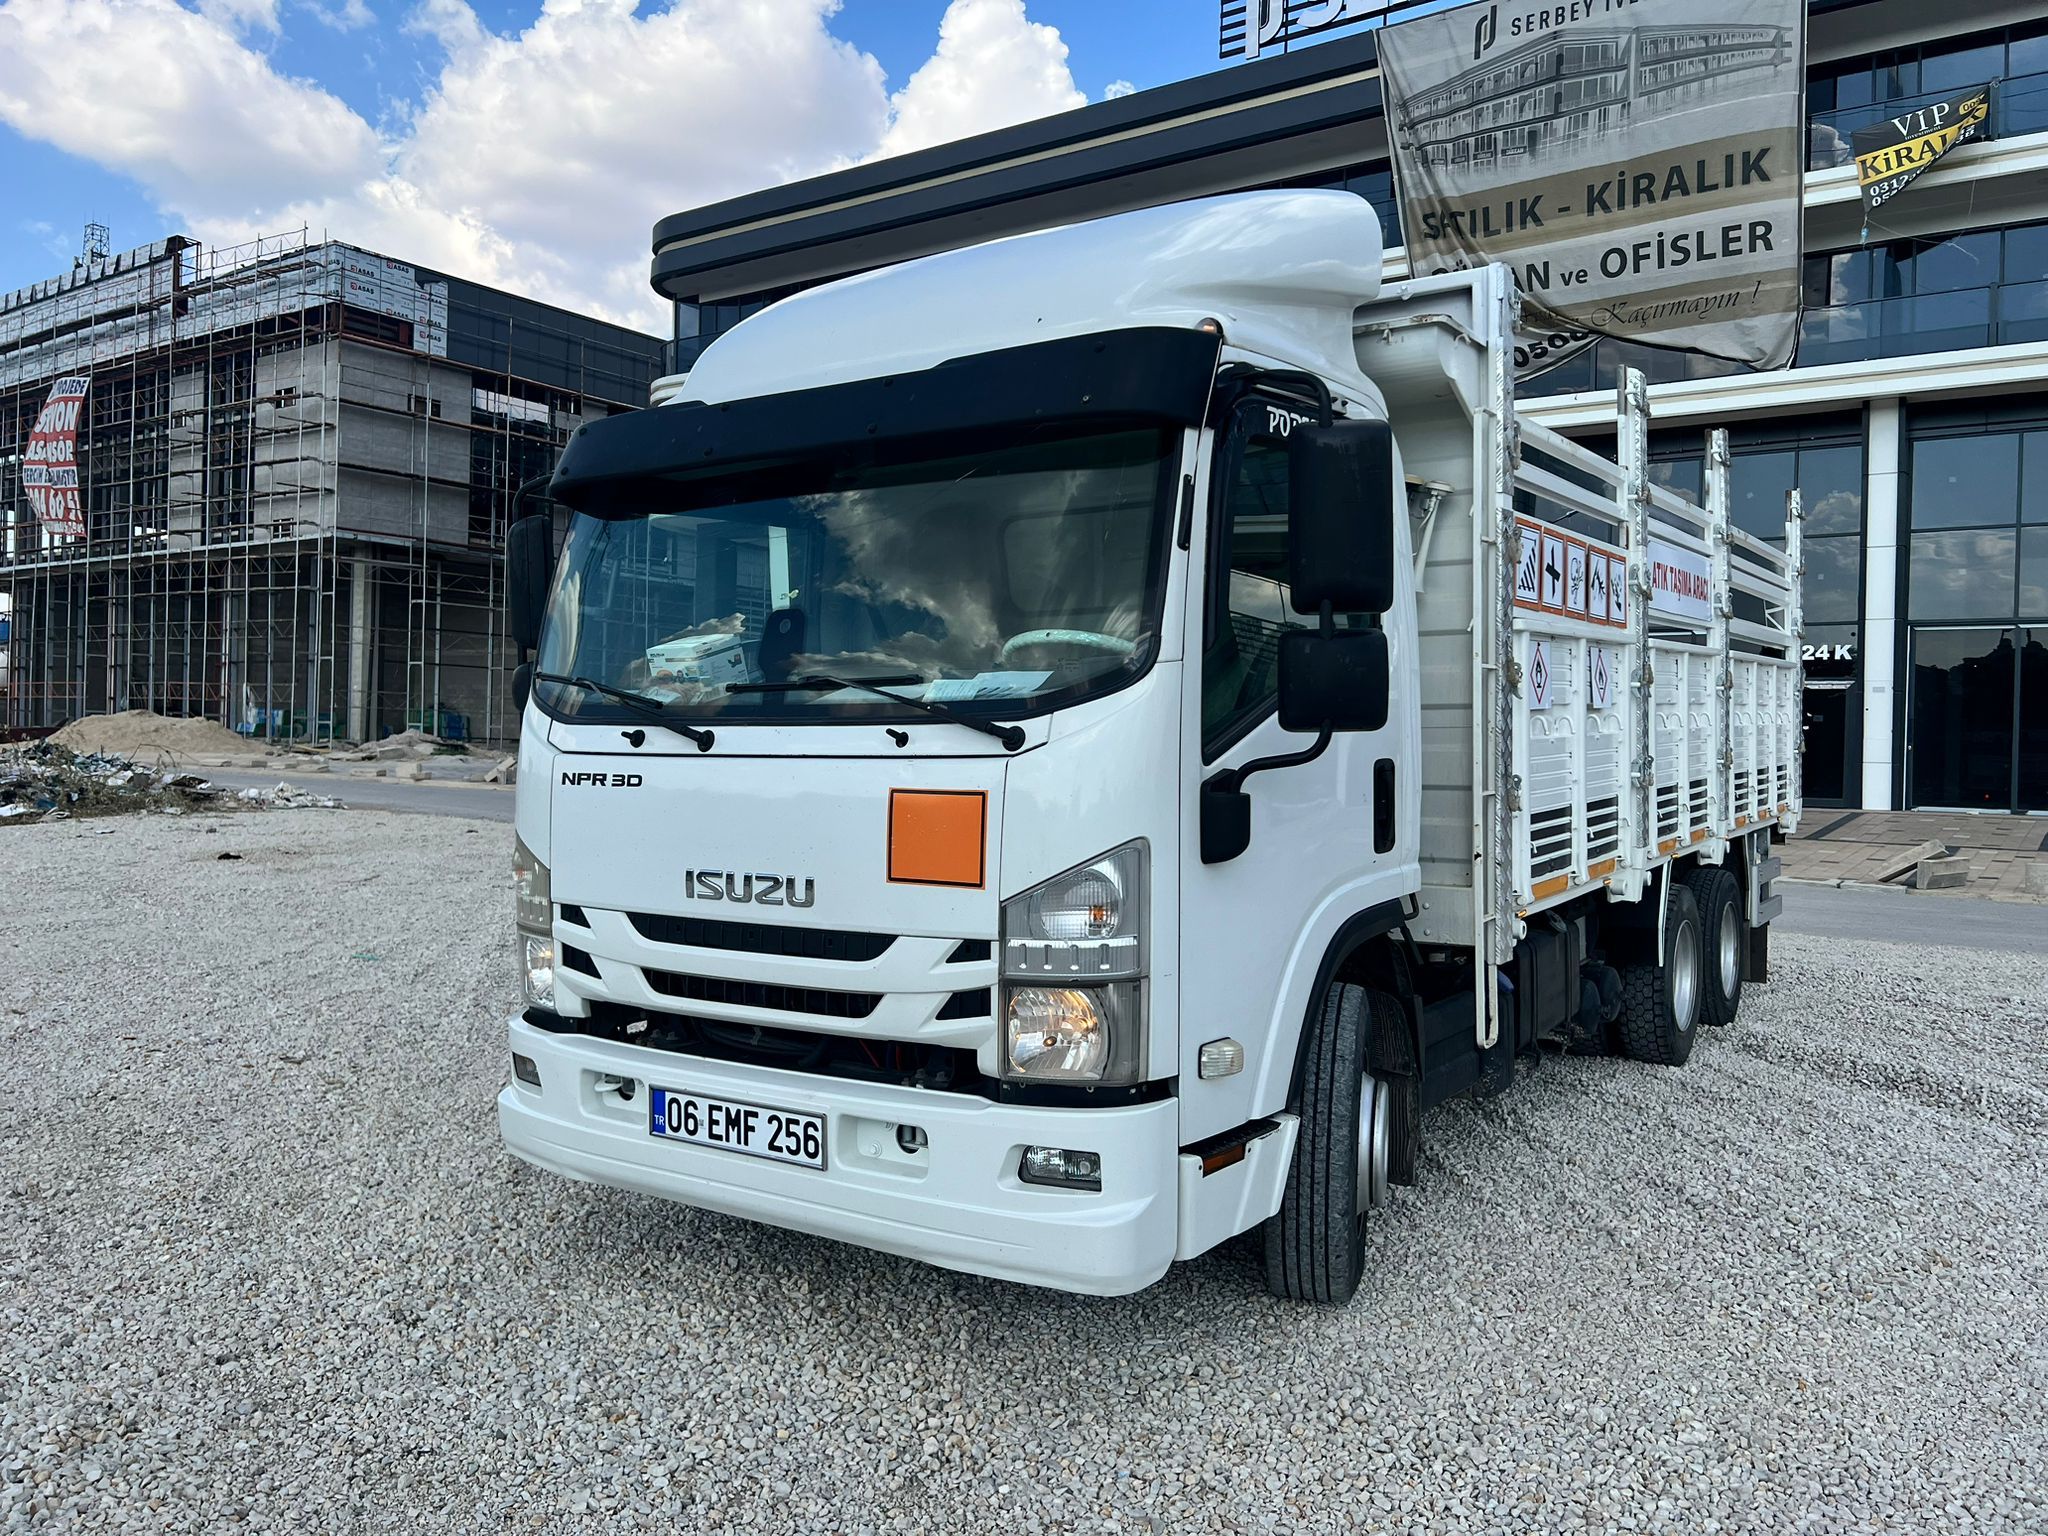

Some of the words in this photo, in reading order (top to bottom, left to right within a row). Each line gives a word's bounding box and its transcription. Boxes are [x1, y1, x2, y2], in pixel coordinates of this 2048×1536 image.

[1511, 0, 1593, 36] SERBEY
[1892, 102, 1950, 136] VIP
[1586, 147, 1772, 217] KİRALIK
[393, 264, 410, 274] ASAS
[1560, 268, 1588, 287] ve
[1600, 220, 1774, 279] OFİSLER
[358, 268, 375, 278] ASAS
[358, 285, 375, 295] ASAS
[1591, 292, 1739, 328] Kaçırmayın
[1652, 561, 1668, 591] ATIK
[1802, 644, 1830, 661] 24
[1834, 644, 1853, 660] K
[562, 772, 607, 787] NPR
[611, 774, 643, 787] 3D
[685, 868, 815, 908] ISUZU
[654, 1114, 665, 1127] TR
[667, 1097, 699, 1136] 06
[708, 1104, 759, 1147] EMF
[768, 1114, 820, 1160] 256
